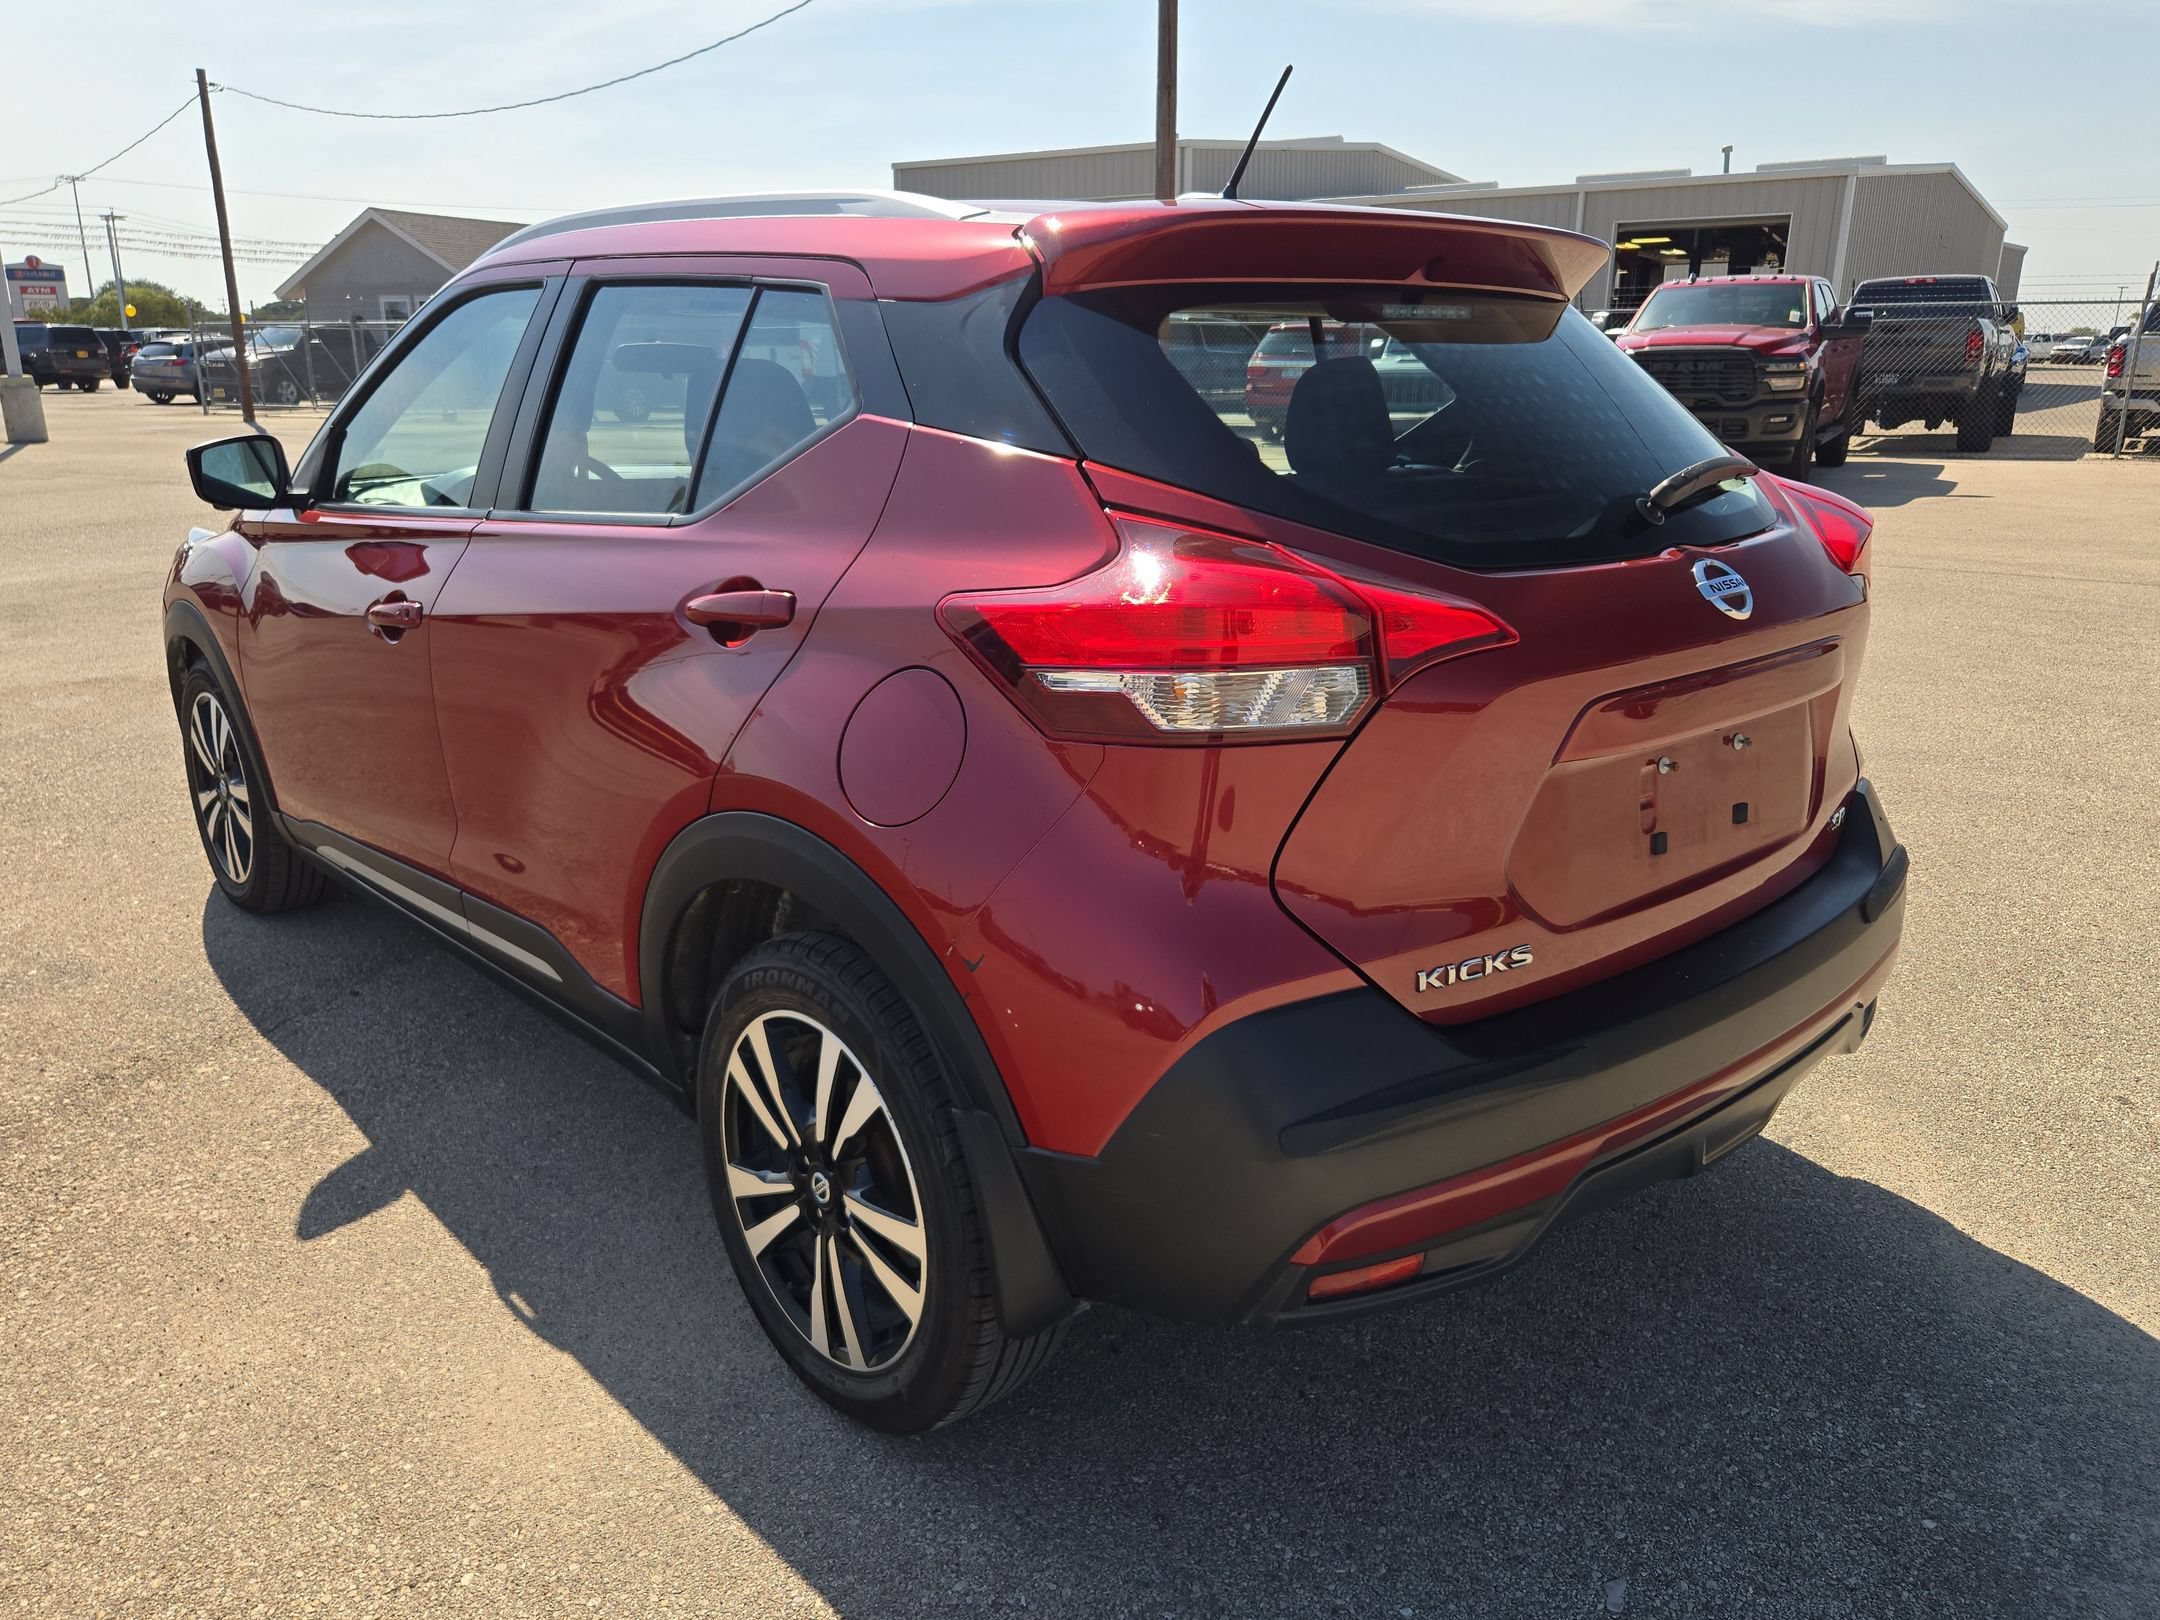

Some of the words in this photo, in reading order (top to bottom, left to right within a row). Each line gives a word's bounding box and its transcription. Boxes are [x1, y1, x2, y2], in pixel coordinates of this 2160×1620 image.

[1653, 360, 1721, 372] RAM
[1415, 943, 1534, 993] KICKS
[743, 970, 850, 1023] IRONMAN
